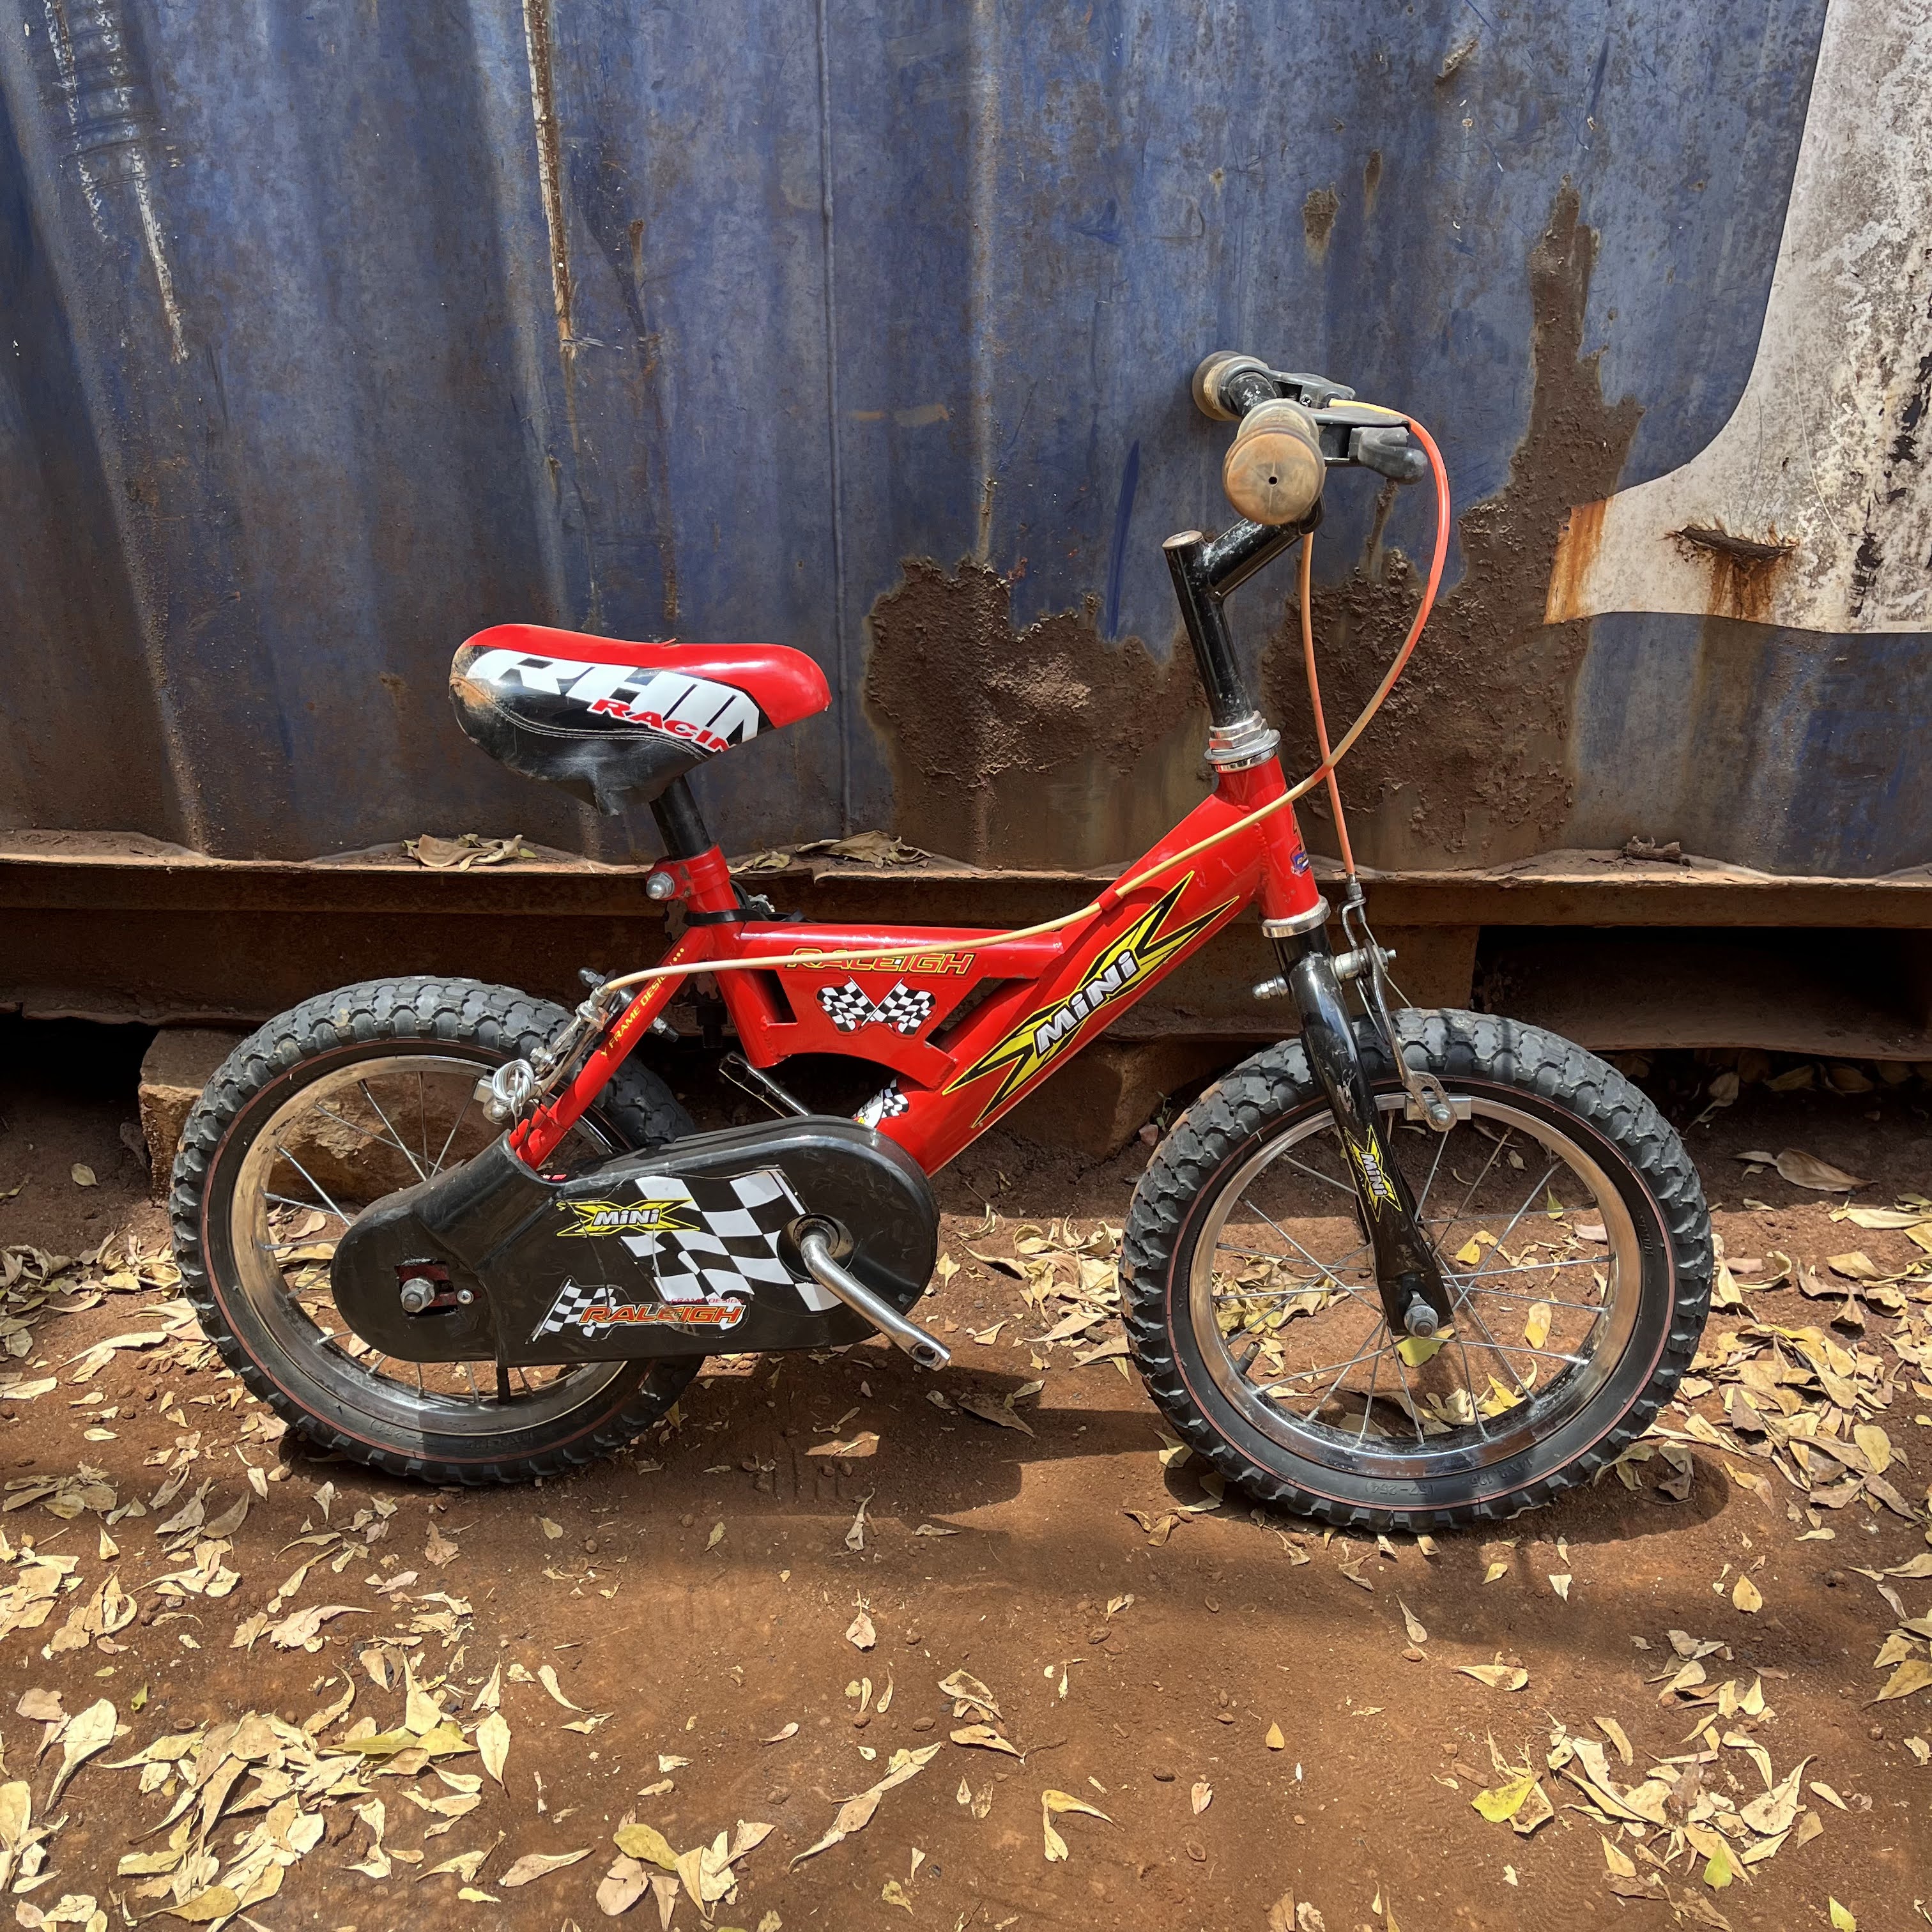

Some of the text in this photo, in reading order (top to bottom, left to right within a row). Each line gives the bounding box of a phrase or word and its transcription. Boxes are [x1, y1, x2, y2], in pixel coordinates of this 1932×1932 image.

[608, 1005, 641, 1048] FRAME
[640, 961, 672, 1007] DESI
[578, 1305, 744, 1323] RALEIGH
